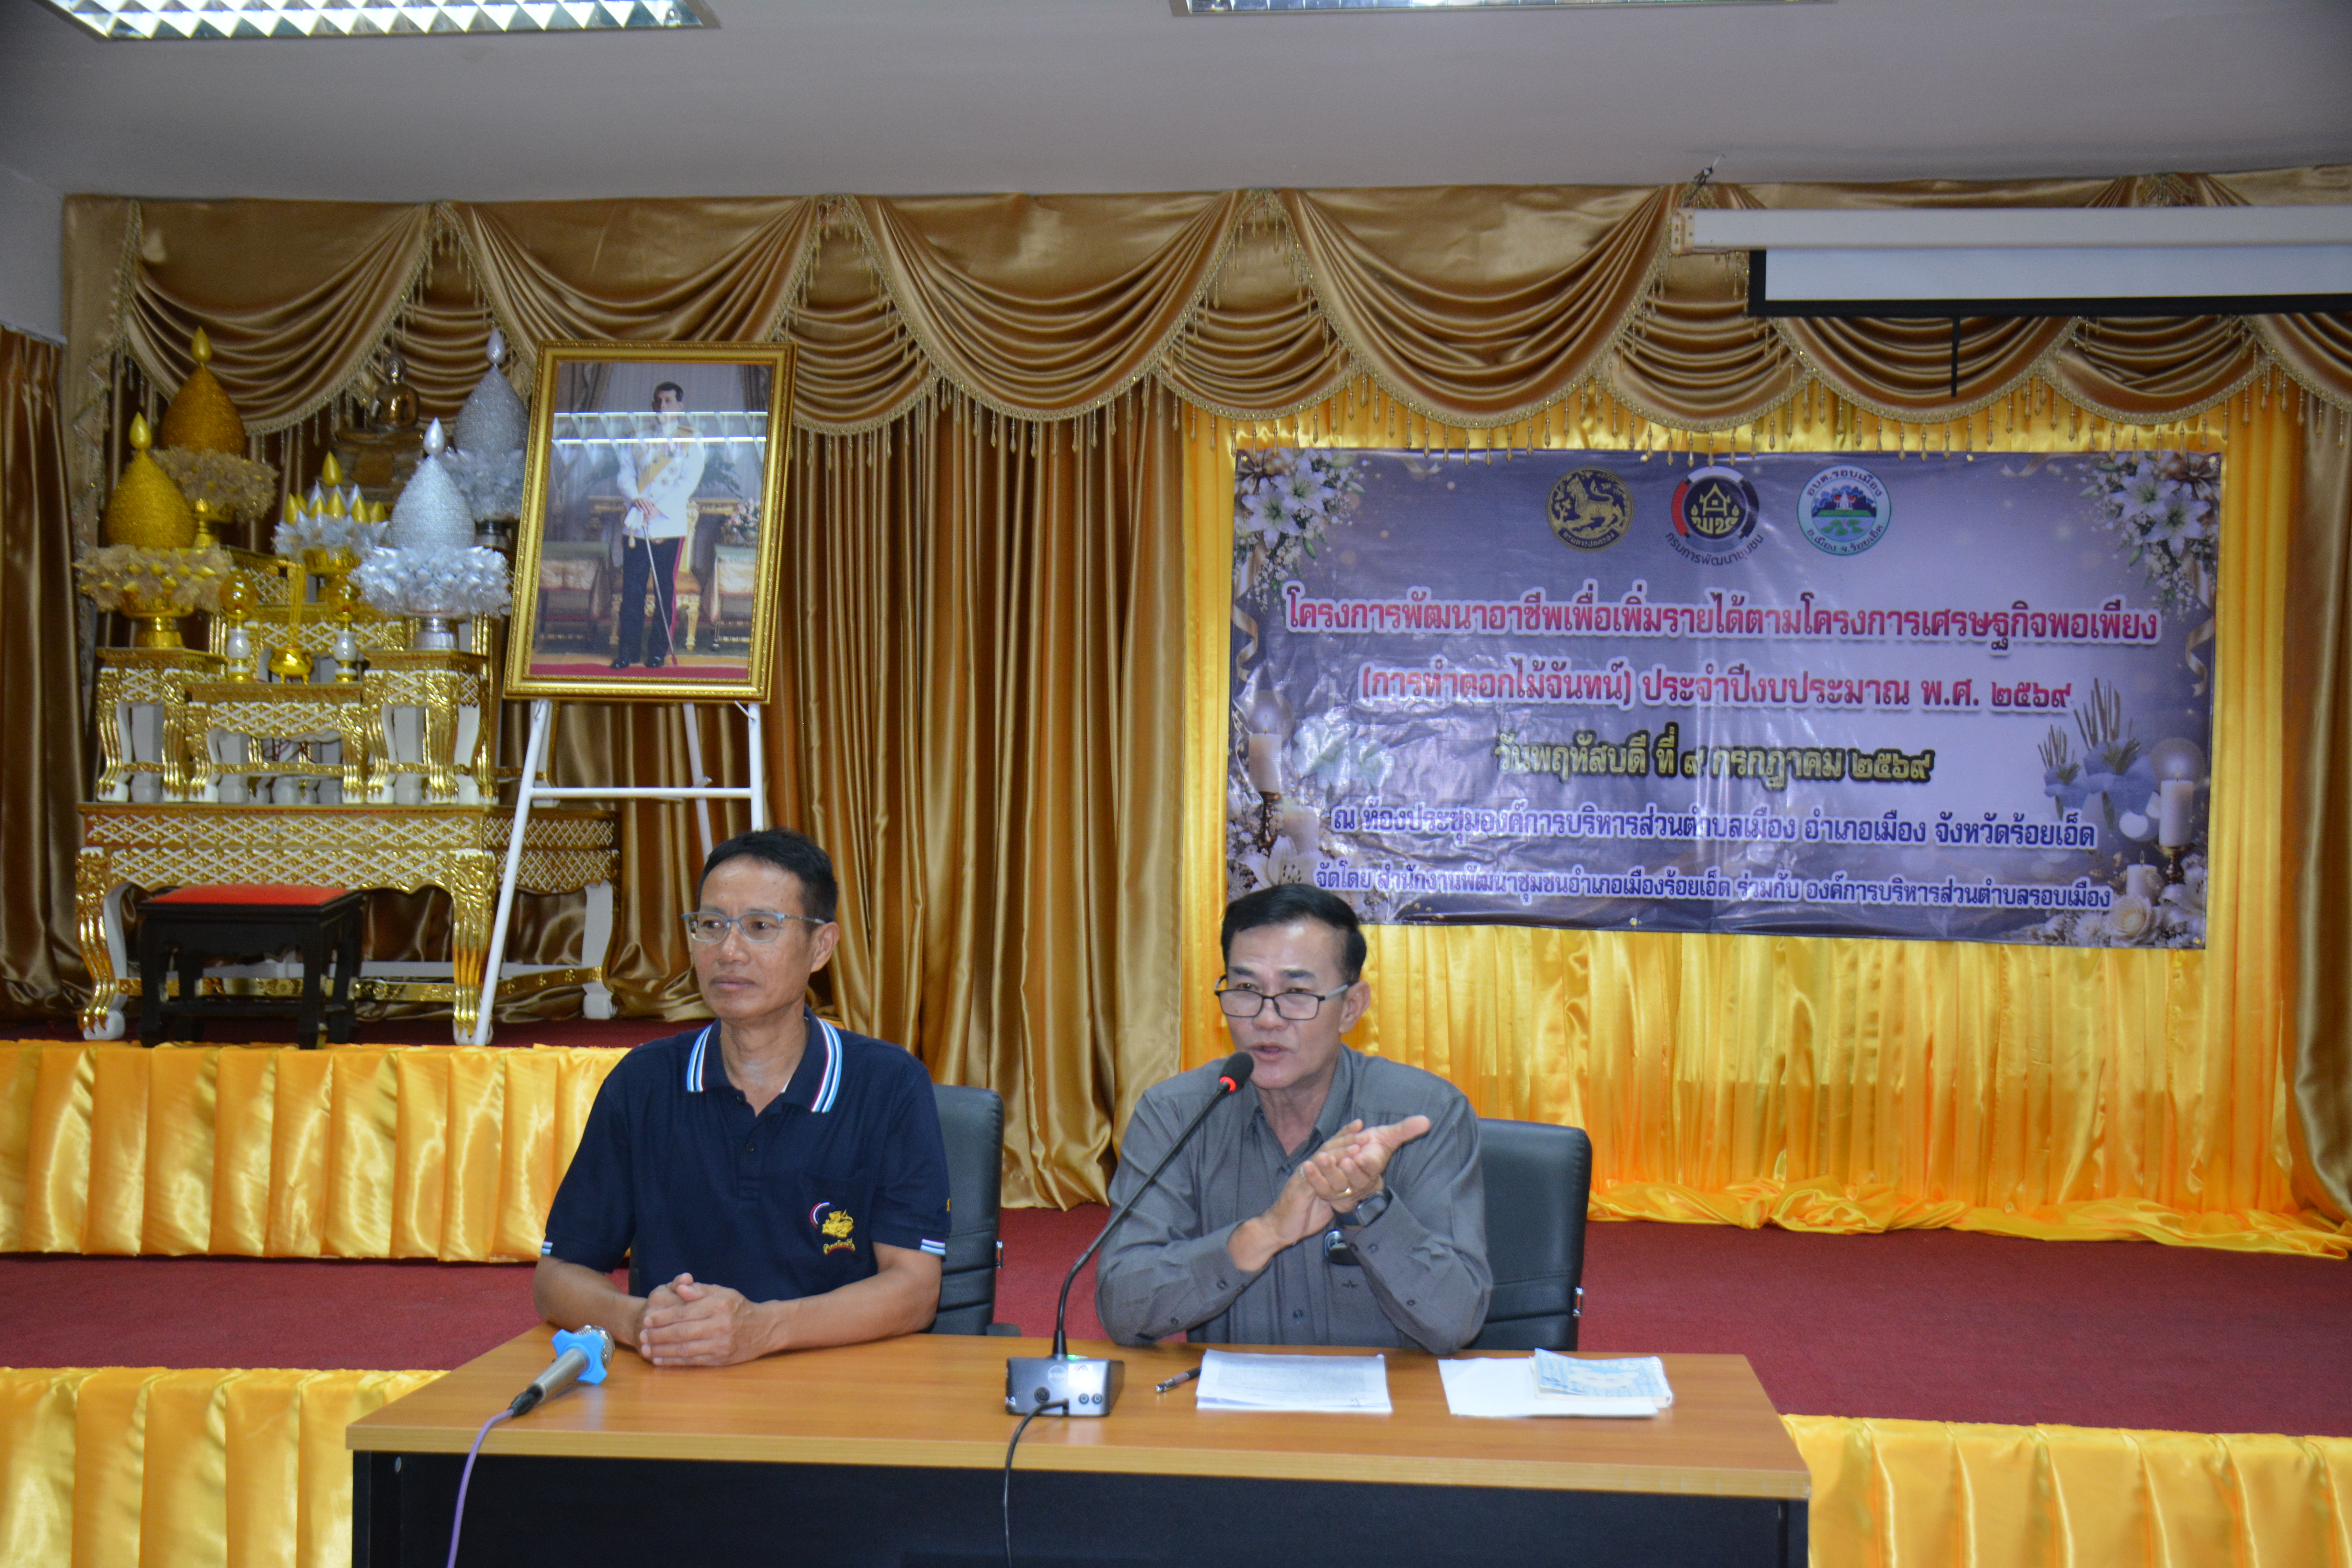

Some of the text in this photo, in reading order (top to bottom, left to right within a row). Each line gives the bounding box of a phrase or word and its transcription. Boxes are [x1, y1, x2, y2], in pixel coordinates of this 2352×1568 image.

[1666, 532, 1764, 566] กรมการพัฒนาชุมชน
[1286, 583, 2157, 650] โครงการพัฒนาอาชีพเพื่อเพิ่มรายได้ตามโครงการเศรษฐกิจพอเพียง
[1362, 657, 2072, 708] (การทำดอกไม้จันทน์) ประจำปีงบประมาณ พ.ศ. ๒๕๖๙
[1494, 726, 1932, 789] วันพฤหัสบดี ที่ ๙ กรกฎาคม ๒๕๖๙
[1334, 798, 2096, 846] ณ ห้องประชุมองค์การบริหารส่วนตำบลเมือง อำเภอเมือง จังหวัดร้อยเอ็ด
[1316, 860, 2111, 908] จัดโดย สำนักงานพัฒนาชุมชนอำเภอเมืองร้อยเอ็ด ร่วมกับ องค์การบริหารส่วนตำบลรอบเมือง
